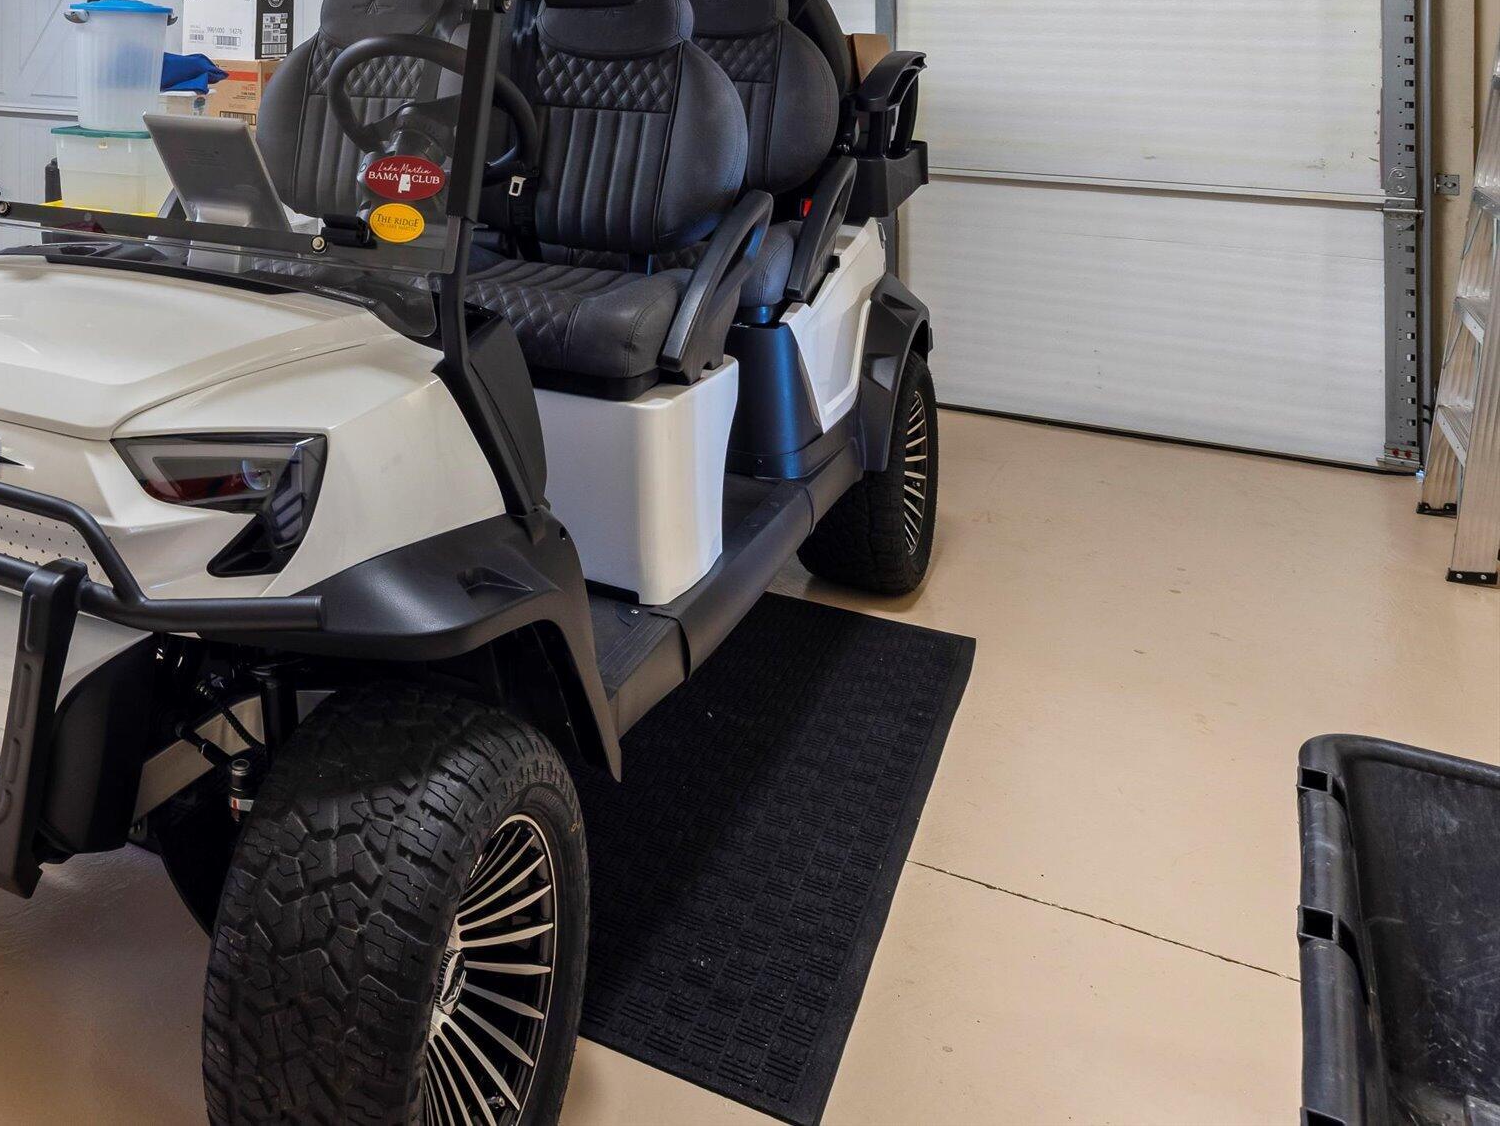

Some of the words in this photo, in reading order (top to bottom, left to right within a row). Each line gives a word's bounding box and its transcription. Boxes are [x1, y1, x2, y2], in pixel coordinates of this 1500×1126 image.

[378, 162, 400, 172] Lake
[400, 162, 432, 175] Martin
[368, 171, 399, 181] BAMA
[411, 175, 440, 184] CLUB
[377, 214, 392, 224] THE
[394, 217, 420, 228] RIDGE
